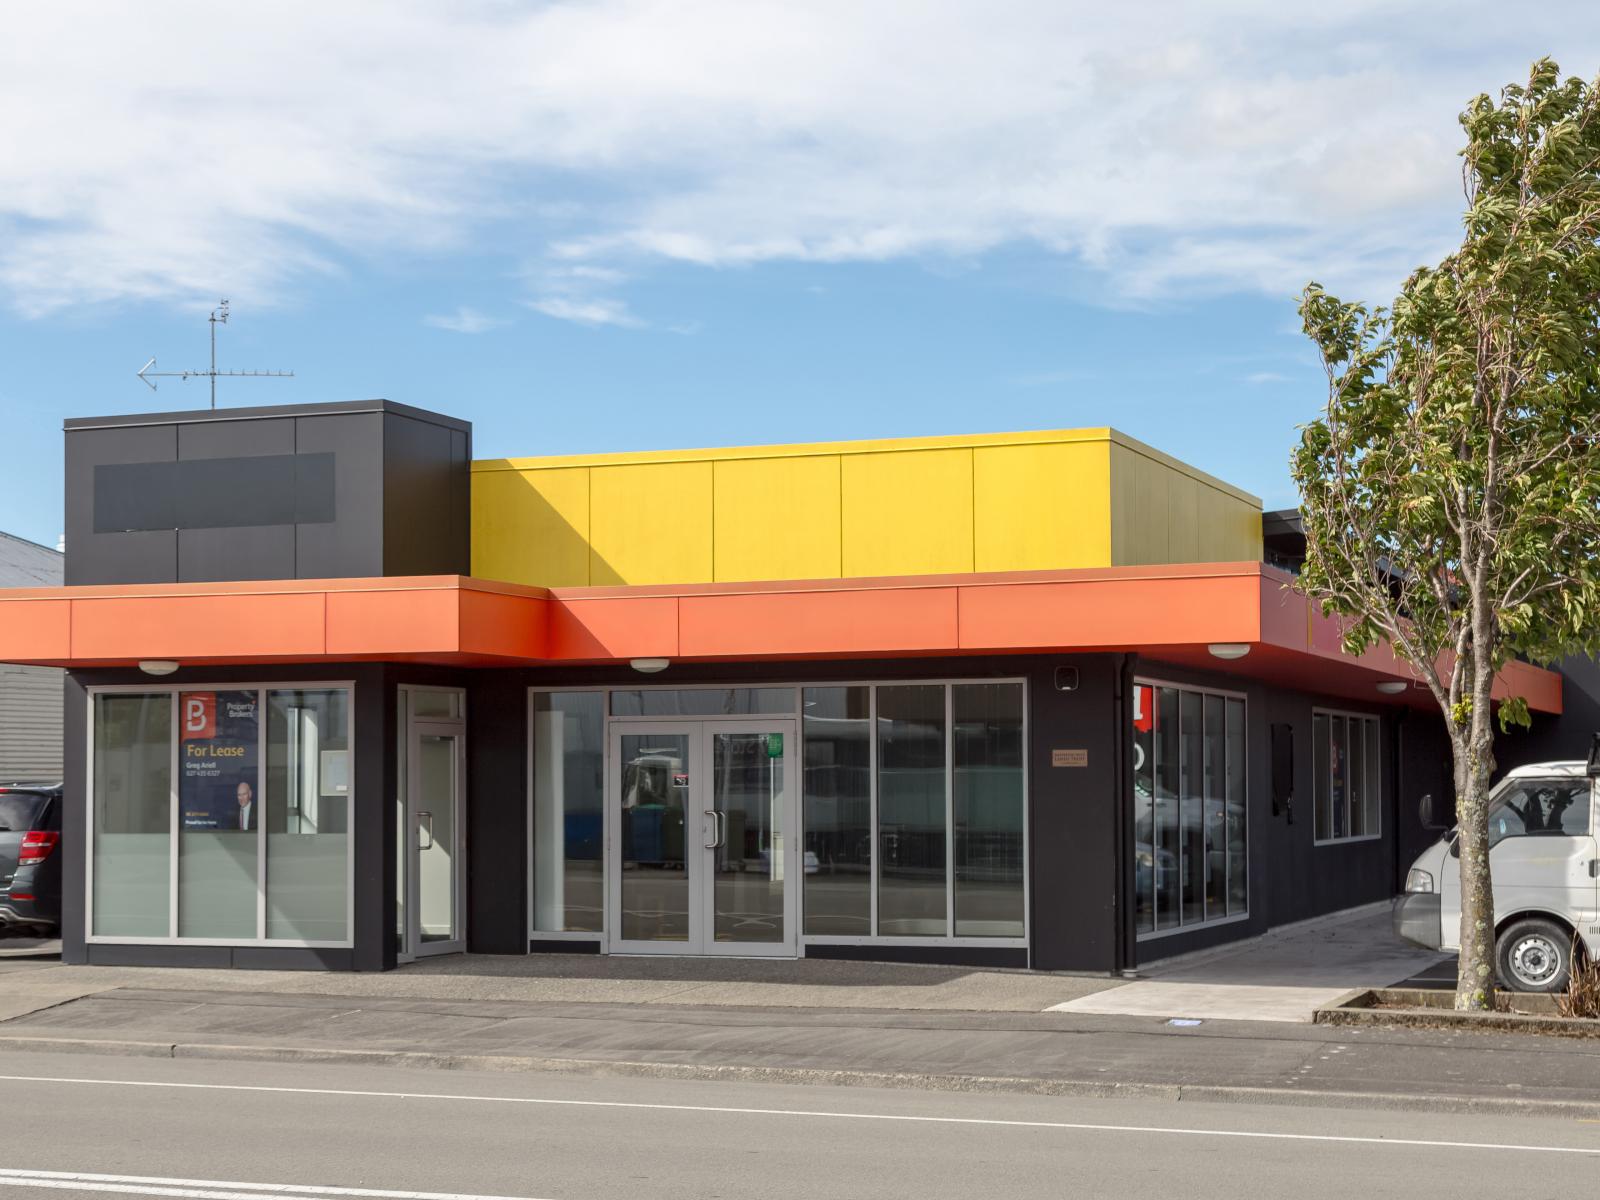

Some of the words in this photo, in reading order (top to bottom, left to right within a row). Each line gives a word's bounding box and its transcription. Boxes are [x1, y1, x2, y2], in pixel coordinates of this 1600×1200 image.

[226, 702, 255, 711] Property
[229, 710, 253, 718] Brokers
[187, 744, 207, 756] For
[210, 744, 244, 756] Lease
[186, 762, 200, 770] Greg
